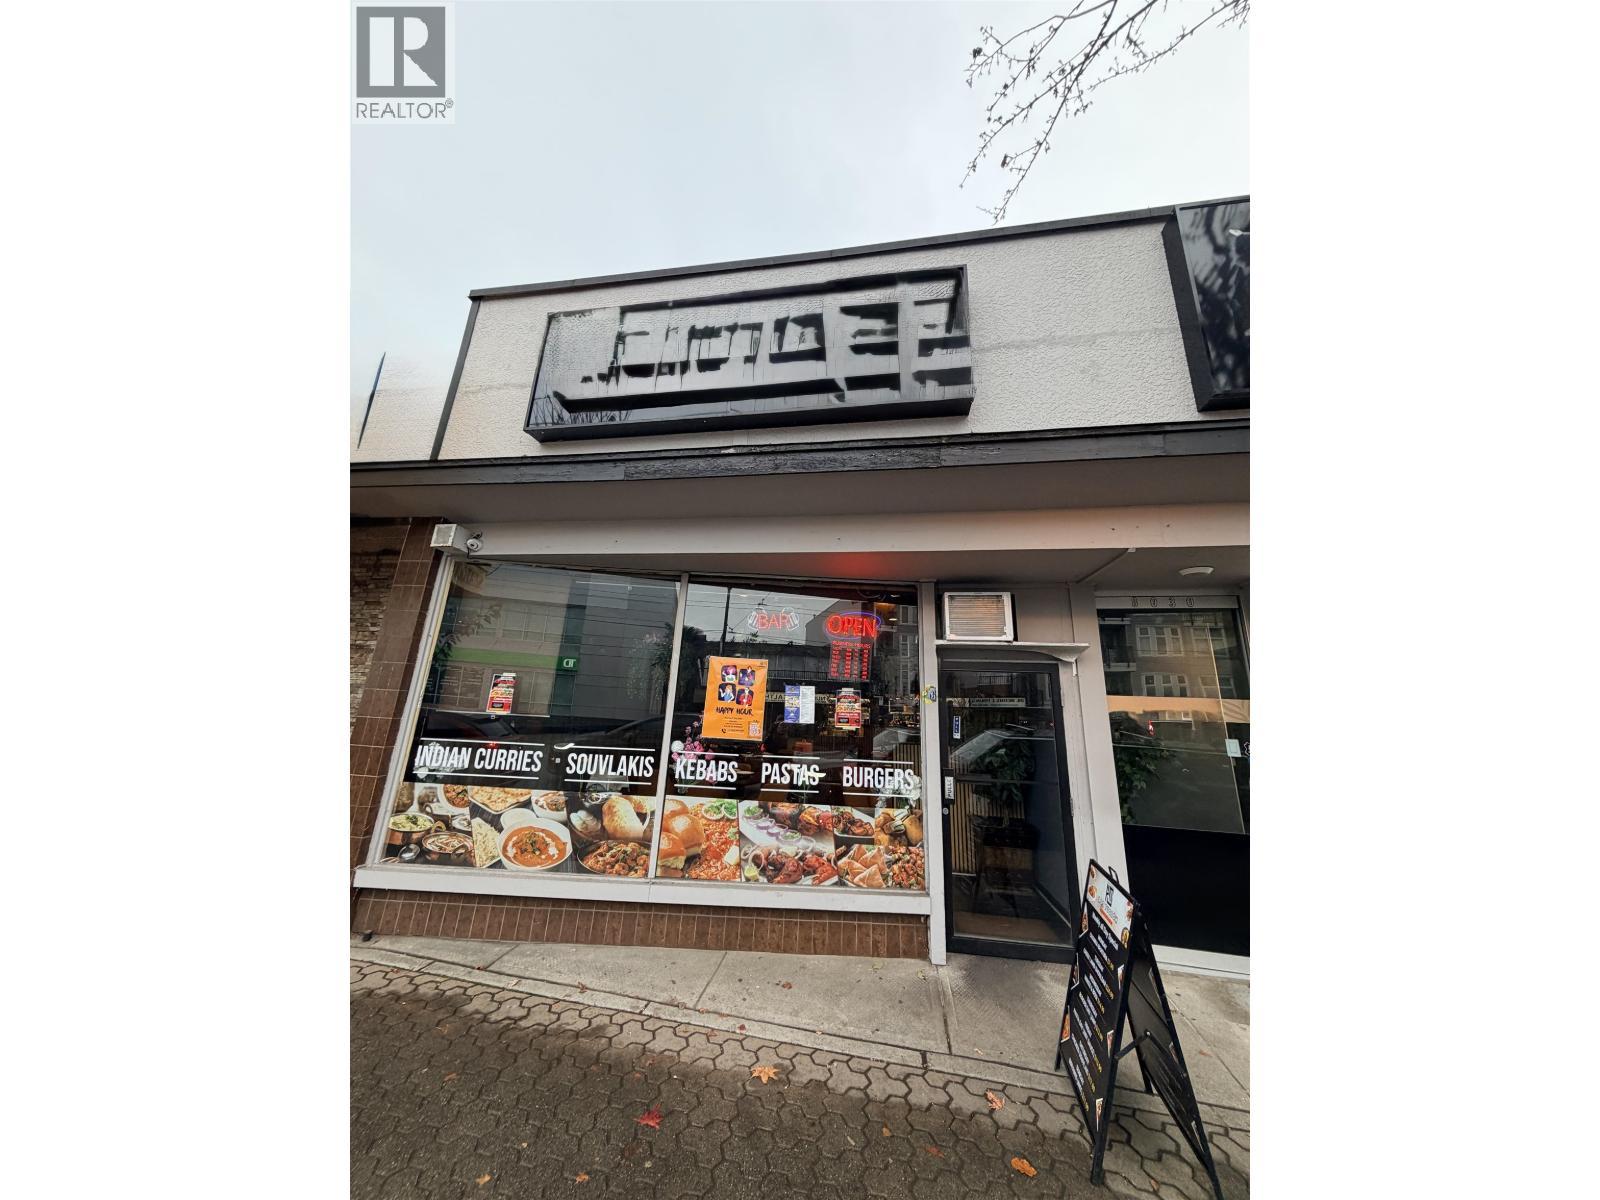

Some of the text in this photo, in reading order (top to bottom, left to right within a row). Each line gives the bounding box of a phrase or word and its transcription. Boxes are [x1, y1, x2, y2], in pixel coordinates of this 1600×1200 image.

[757, 612, 790, 630] BAR
[826, 613, 878, 638] OPEN
[716, 706, 754, 717] HAPPY HOUR
[414, 744, 544, 772] INDIAN CURRIES
[565, 752, 655, 778] SOUVLAKIS
[674, 760, 739, 783] KEBABS
[760, 762, 821, 786] PASTAS
[842, 766, 915, 790] BURGERS
